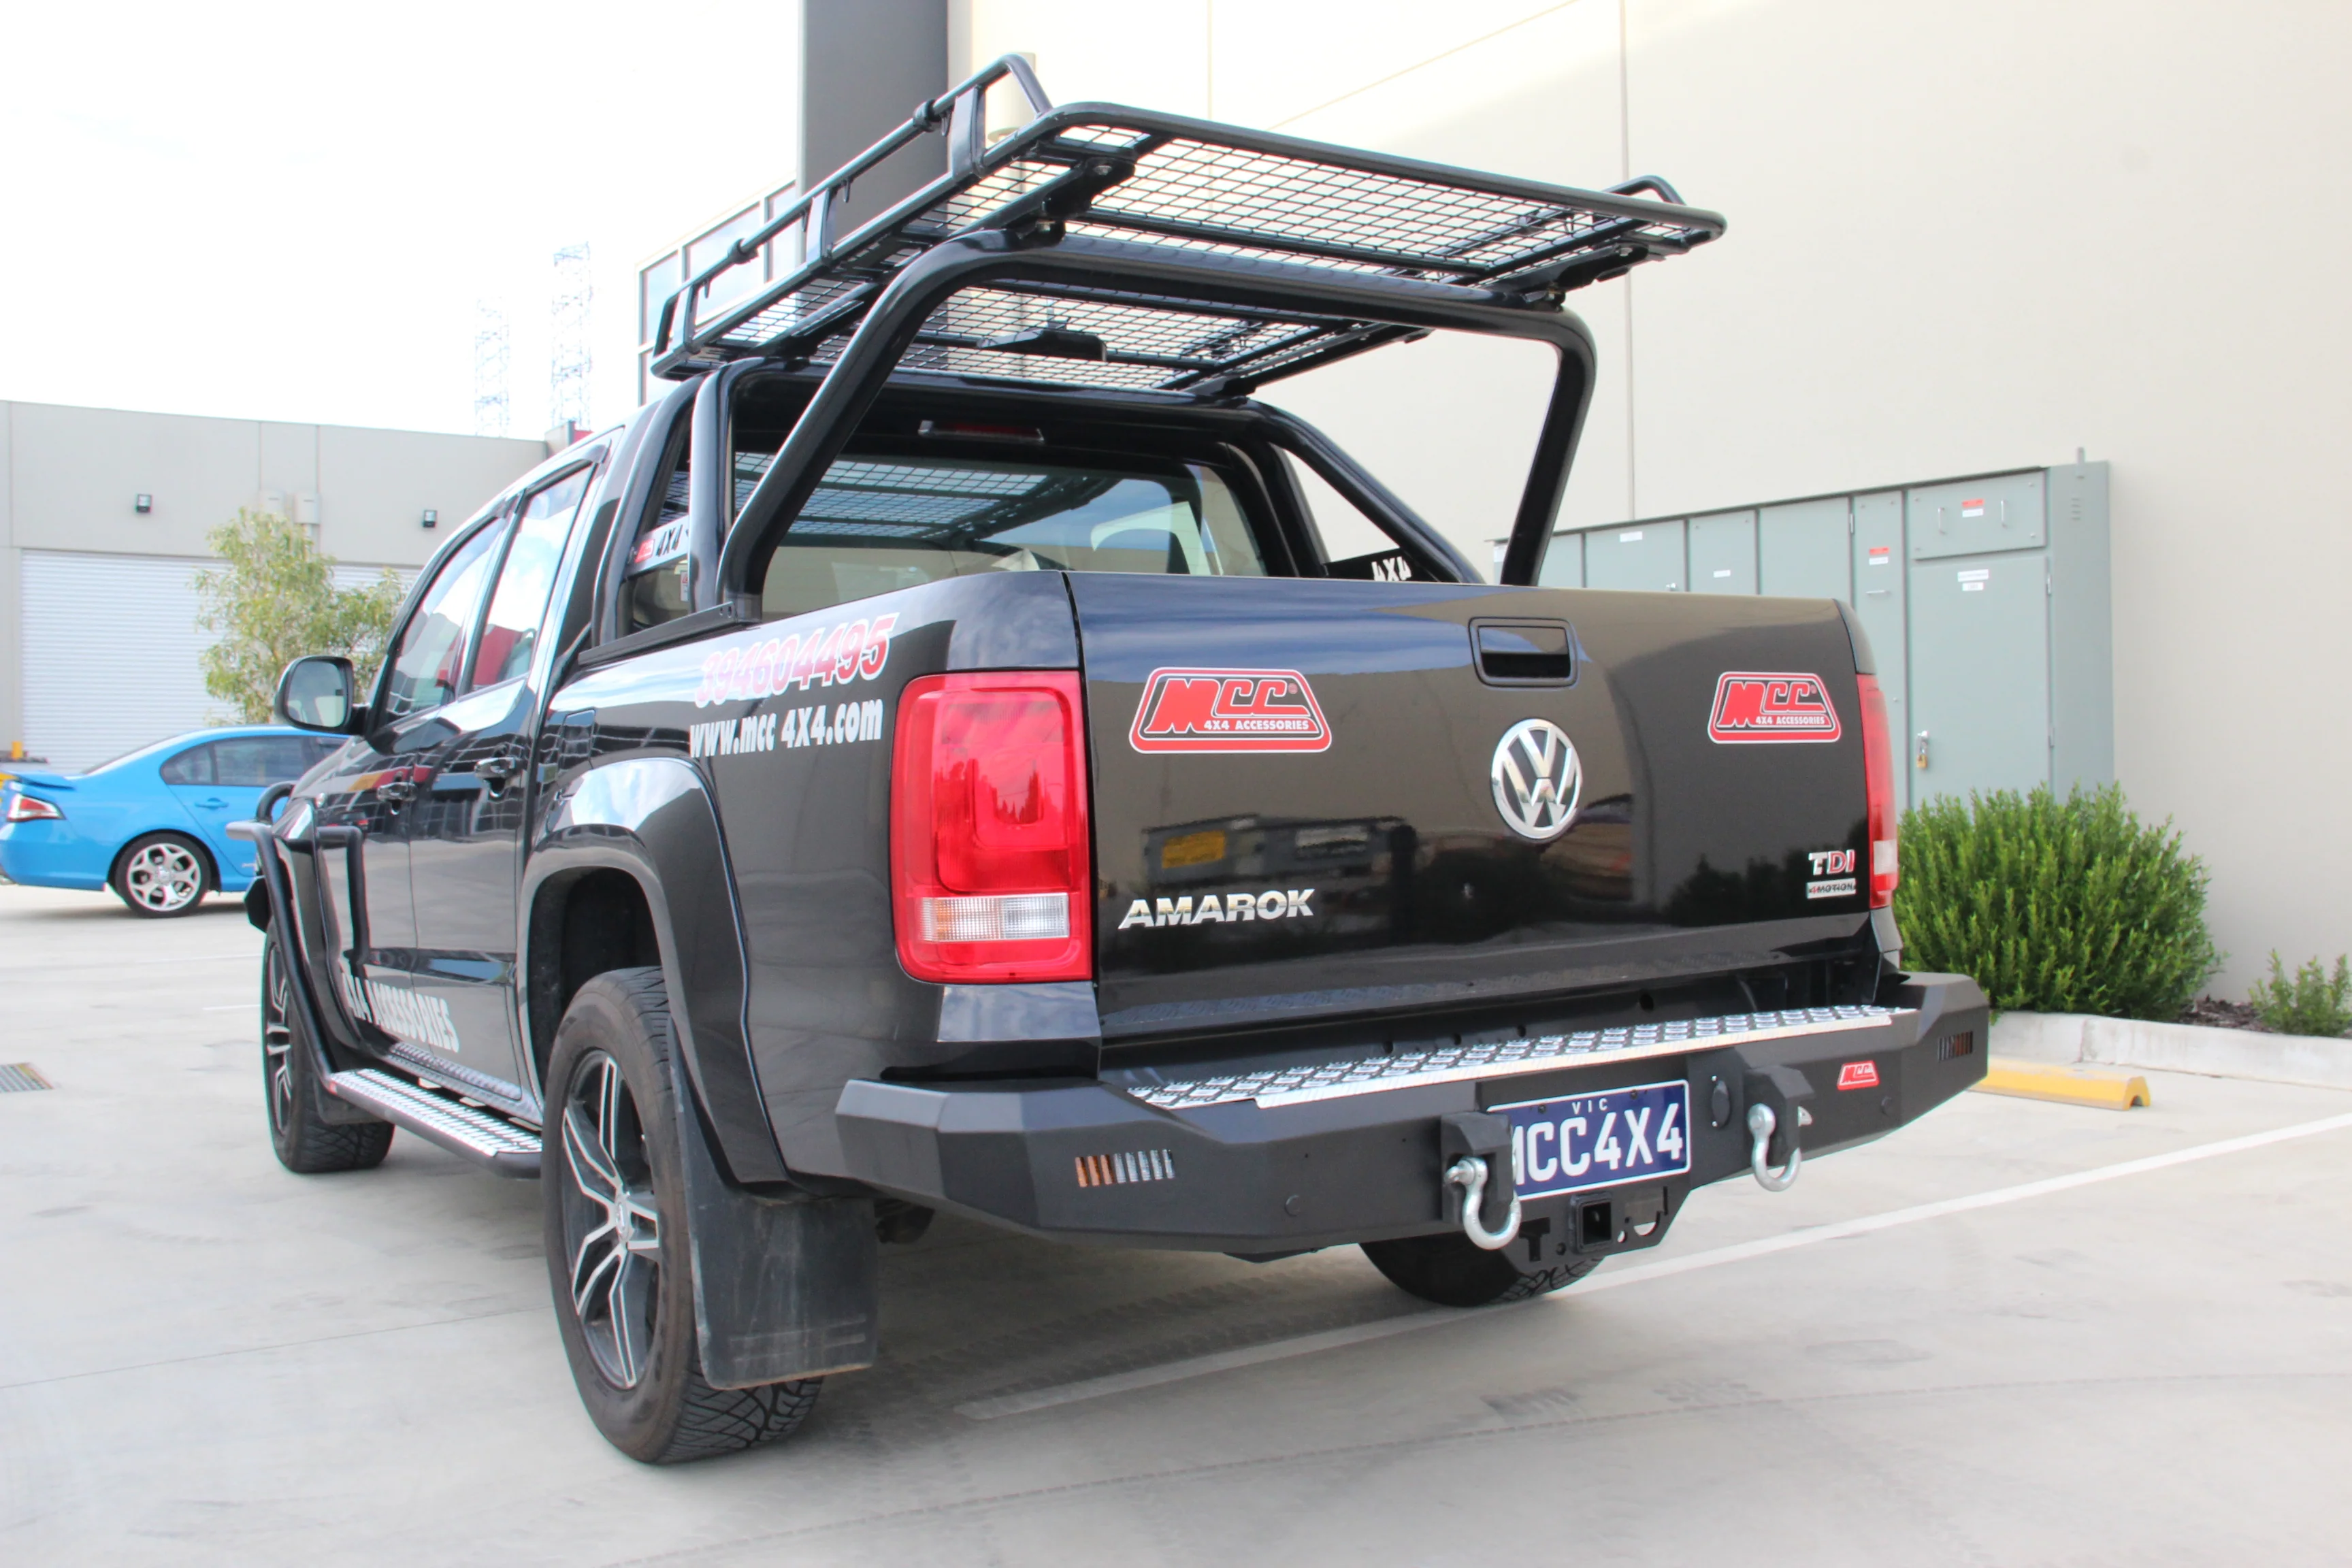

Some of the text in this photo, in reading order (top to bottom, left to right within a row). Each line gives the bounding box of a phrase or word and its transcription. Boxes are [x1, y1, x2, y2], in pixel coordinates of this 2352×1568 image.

[695, 612, 900, 708] 394604495
[1144, 679, 1311, 734] MCC
[1204, 719, 1309, 730] 4X4 ACCESSORIES
[1716, 681, 1826, 728] MCC
[1755, 716, 1825, 725] 4X4 ACCESSORIES
[689, 699, 883, 757] www.mcc 4X4.com
[1808, 849, 1855, 876] TDI
[1118, 888, 1315, 930] AMAROK
[1572, 1098, 1608, 1115] VIC
